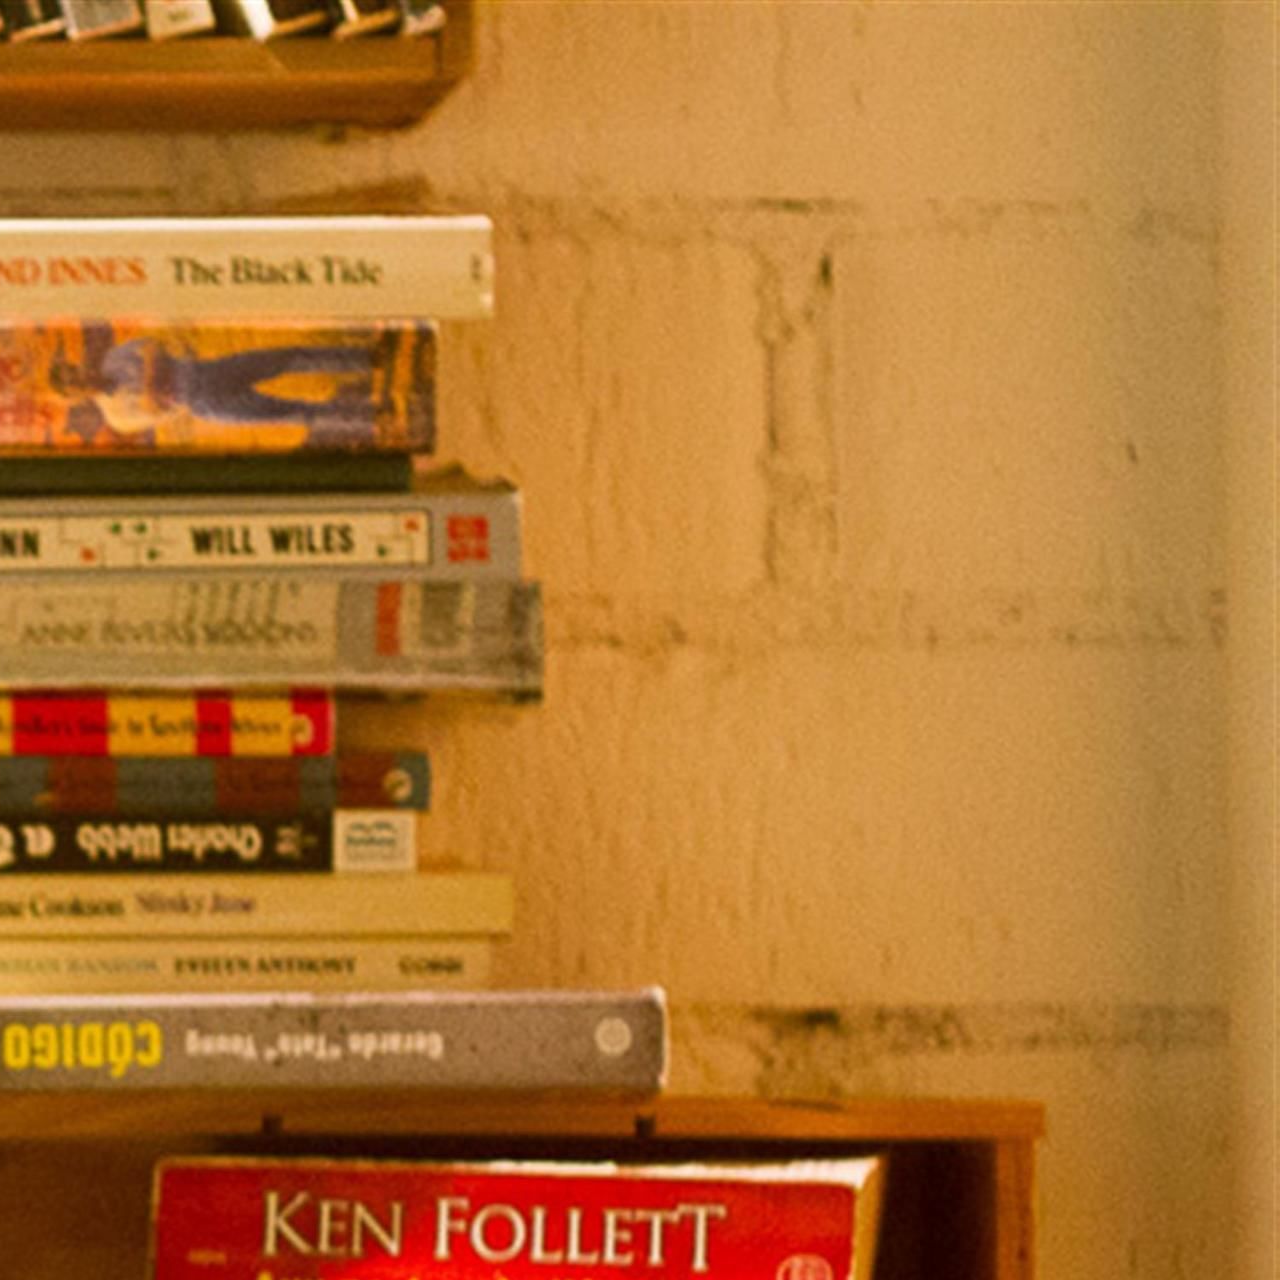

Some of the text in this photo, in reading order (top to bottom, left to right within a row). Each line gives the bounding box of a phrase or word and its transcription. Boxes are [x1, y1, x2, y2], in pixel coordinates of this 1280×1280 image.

[49, 256, 147, 287] INNES
[172, 256, 224, 287] The
[231, 255, 316, 287] Black
[320, 256, 383, 286] Tide
[191, 525, 355, 557] WILL WILES
[75, 823, 162, 860] Webb
[28, 893, 126, 919] Cookson
[3, 1021, 163, 1079] CÓDIGO
[348, 1030, 443, 1060] Gerardo
[262, 1190, 727, 1272] KEN FOLLETT
